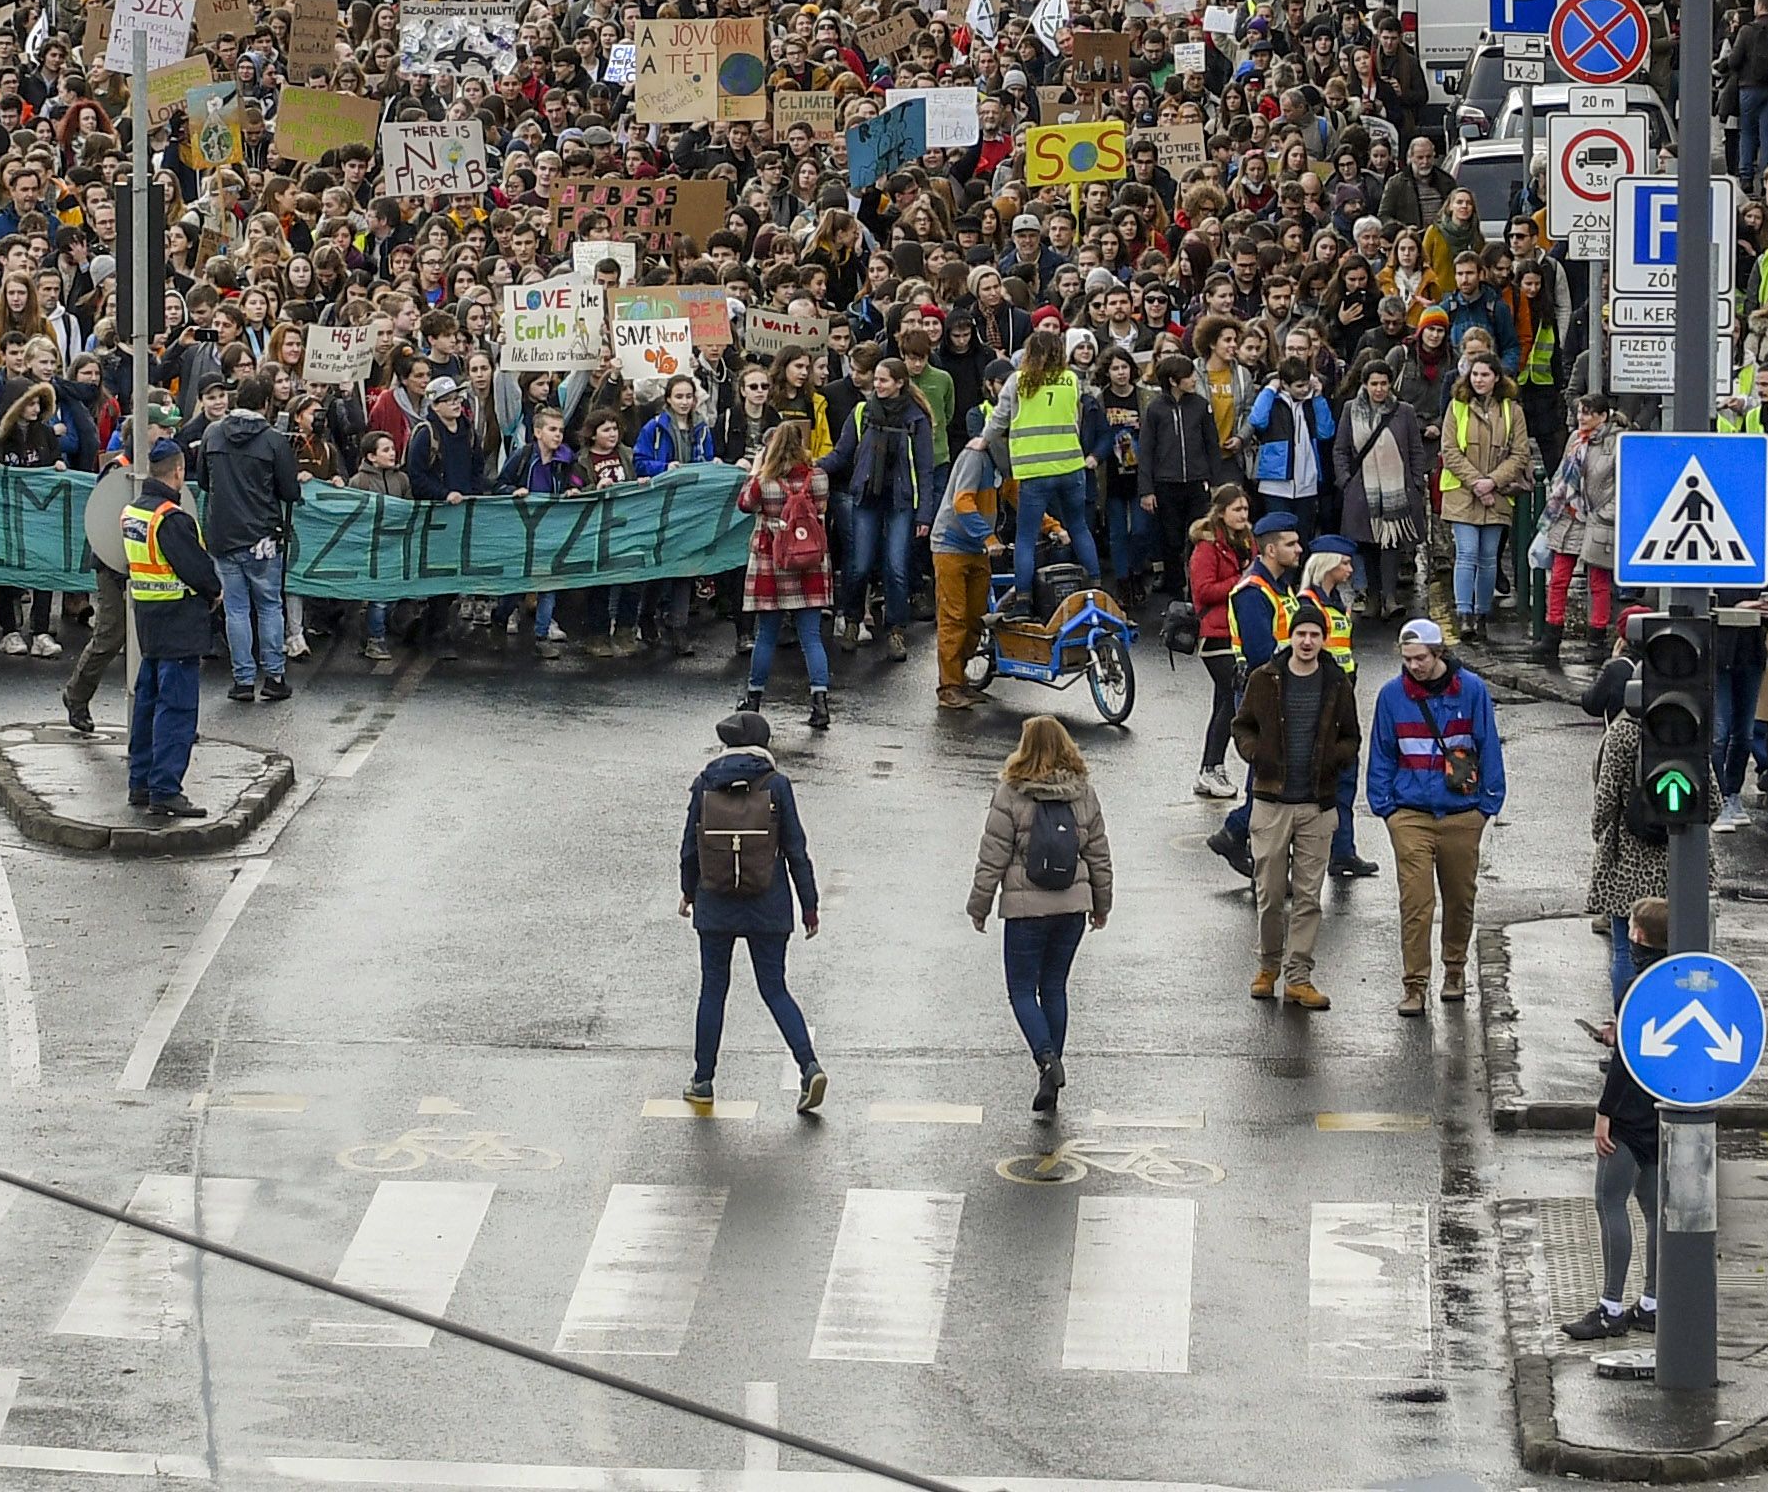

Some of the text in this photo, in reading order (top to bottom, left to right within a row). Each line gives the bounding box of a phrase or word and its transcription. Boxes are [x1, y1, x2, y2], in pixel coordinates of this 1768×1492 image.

[641, 20, 752, 47] A JÖVŐNK
[861, 18, 905, 43] TRUST
[641, 49, 715, 74] A TÉT
[778, 95, 833, 109] CLIMATE
[1581, 95, 1614, 108] 20 m
[399, 125, 471, 139] THERE IS
[1035, 129, 1125, 182] SOS
[1165, 142, 1201, 154] OTHER
[1177, 154, 1201, 164] THE
[395, 159, 486, 193] Planet B
[513, 287, 600, 311] LOVE the
[514, 313, 567, 341] Earth
[616, 325, 652, 346] SAVE
[656, 324, 689, 344] Nemo!
[752, 315, 759, 328] I
[807, 325, 819, 336] A
[1619, 336, 1666, 352] FIZETŐ
[1045, 391, 1055, 407] 7
